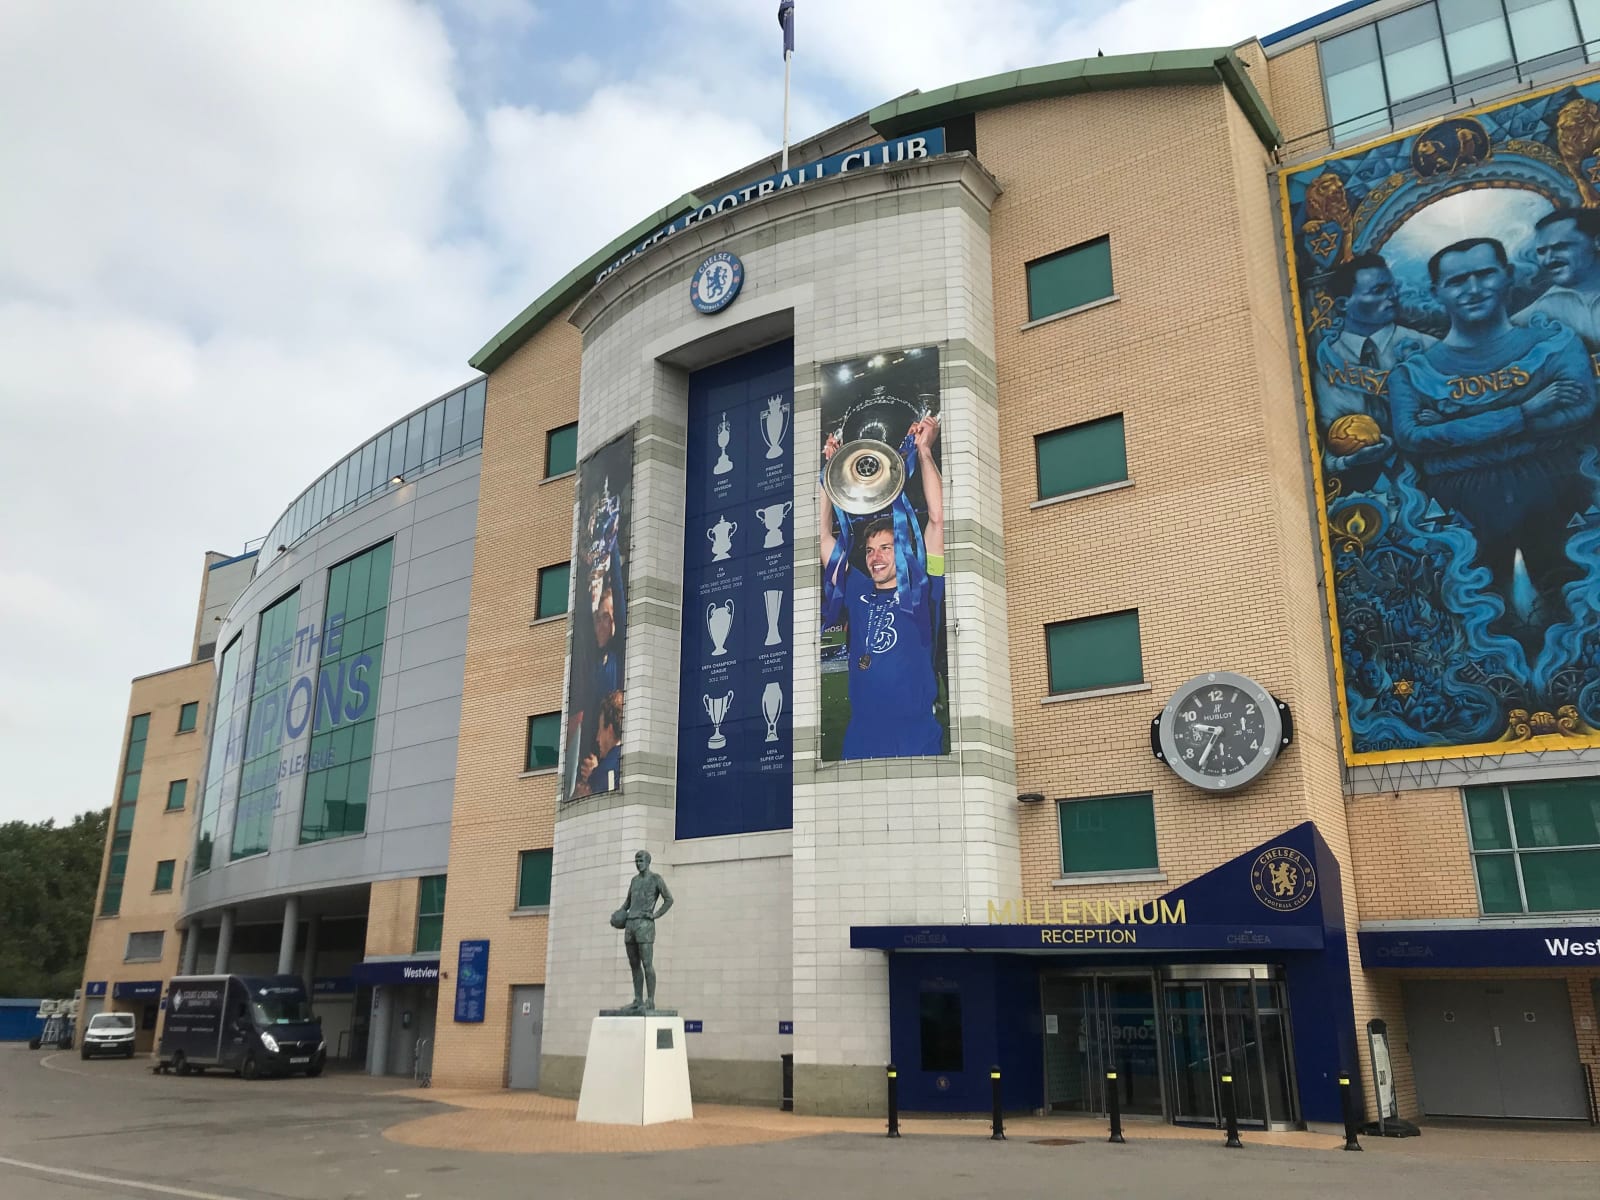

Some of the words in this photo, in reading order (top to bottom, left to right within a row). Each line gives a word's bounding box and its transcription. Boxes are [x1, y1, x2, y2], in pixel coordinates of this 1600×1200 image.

[698, 252, 731, 273] CHELSEA
[1325, 360, 1390, 395] WEISZ
[1446, 365, 1531, 399] JONES
[295, 612, 346, 668] THE
[764, 657, 782, 665] LEAGUE
[1207, 690, 1224, 702] 12
[1245, 703, 1255, 715] 2
[1182, 710, 1197, 722] 10
[1203, 712, 1233, 721] HUBLOT
[1250, 739, 1259, 751] 4
[1185, 748, 1195, 759] 8
[1260, 849, 1301, 864] CHELSEA
[1264, 897, 1293, 909] FOOTBALL
[987, 899, 1187, 925] MILLENNIUM
[1041, 929, 1137, 944] RECEPTION
[403, 965, 439, 979] Westview
